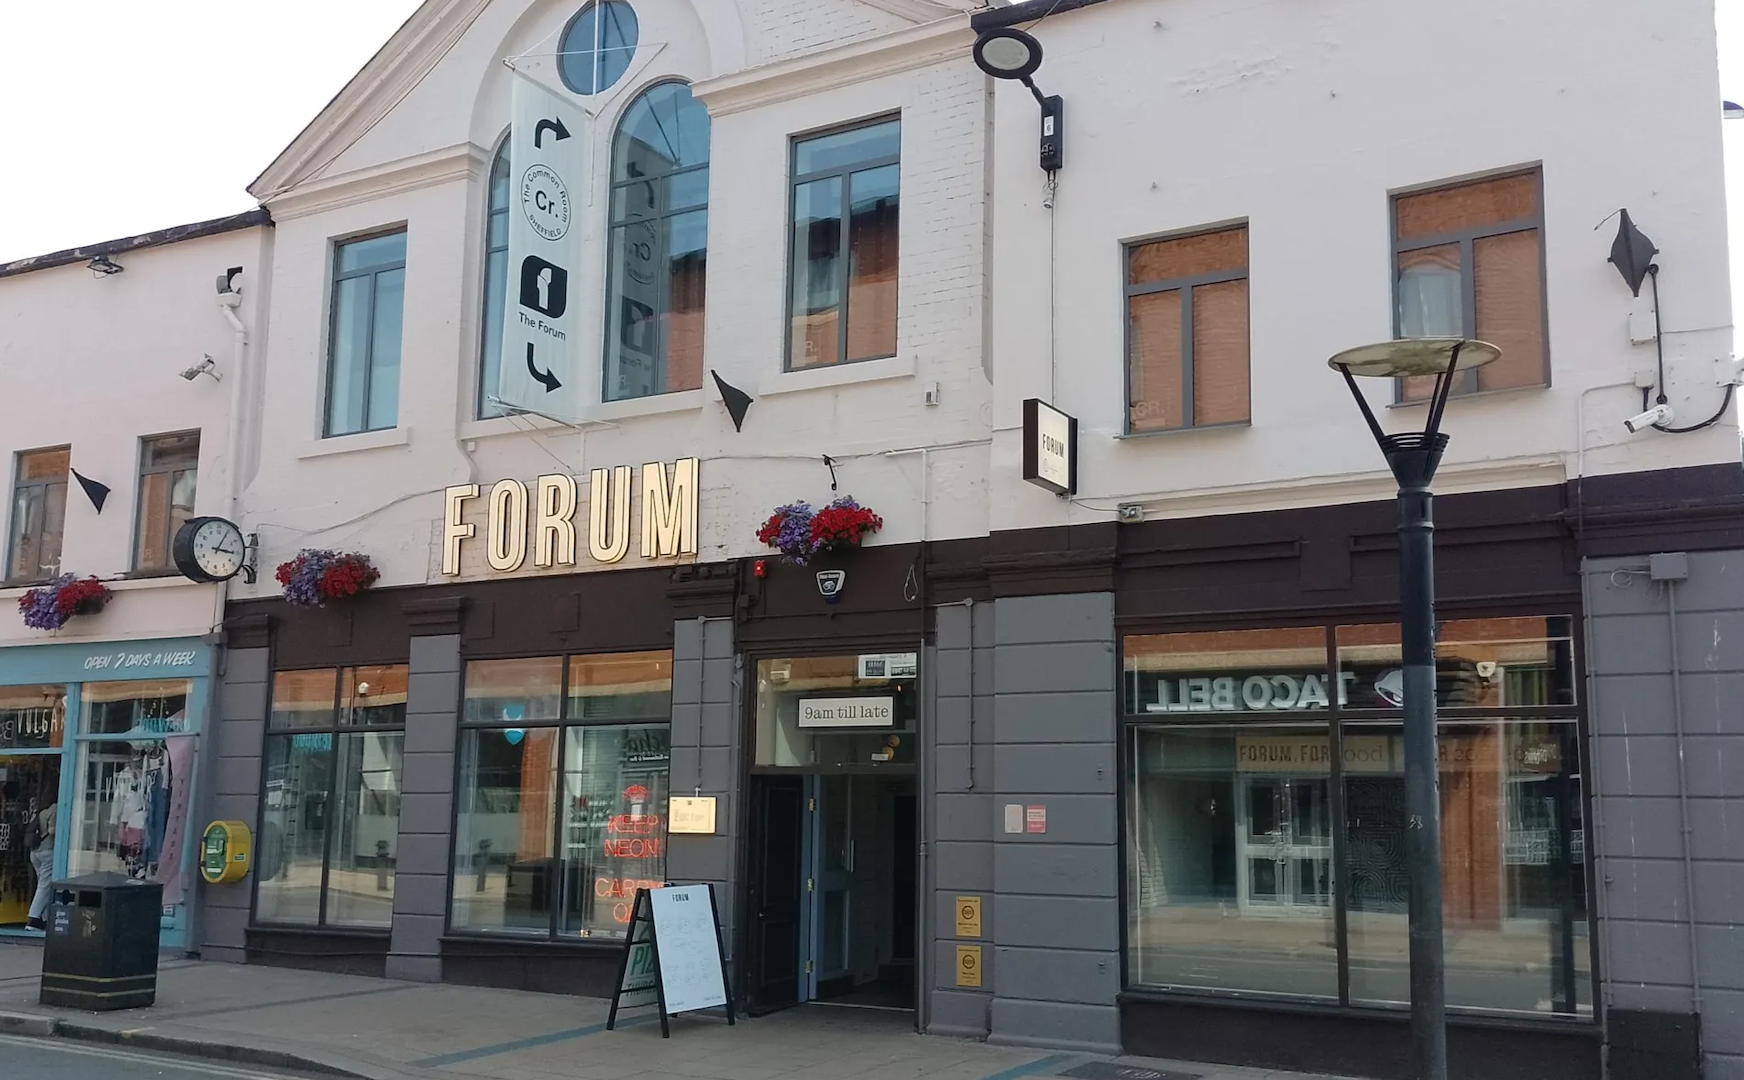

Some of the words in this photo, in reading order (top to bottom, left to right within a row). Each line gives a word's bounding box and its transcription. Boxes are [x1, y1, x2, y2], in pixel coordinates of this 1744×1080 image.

[527, 170, 560, 189] Common
[559, 190, 568, 223] Room
[535, 190, 559, 218] Cr.
[529, 214, 562, 238] SHEFFIELD
[518, 311, 536, 328] The
[538, 320, 566, 341] Forum
[1042, 433, 1065, 459] FORUM
[442, 457, 700, 576] FORUM
[84, 655, 112, 672] OPEN
[114, 652, 125, 670] 7
[125, 653, 152, 667] DAYS
[153, 654, 161, 665] A
[163, 651, 196, 666] WEEK
[804, 706, 834, 720] 9am
[836, 705, 857, 719] till
[859, 705, 889, 718] late
[1300, 745, 1330, 761] FOR
[1343, 744, 1383, 762] ood
[606, 814, 659, 834] KEEP
[604, 838, 660, 858] NEON
[671, 893, 690, 903] FORUM
[613, 902, 633, 923] O
